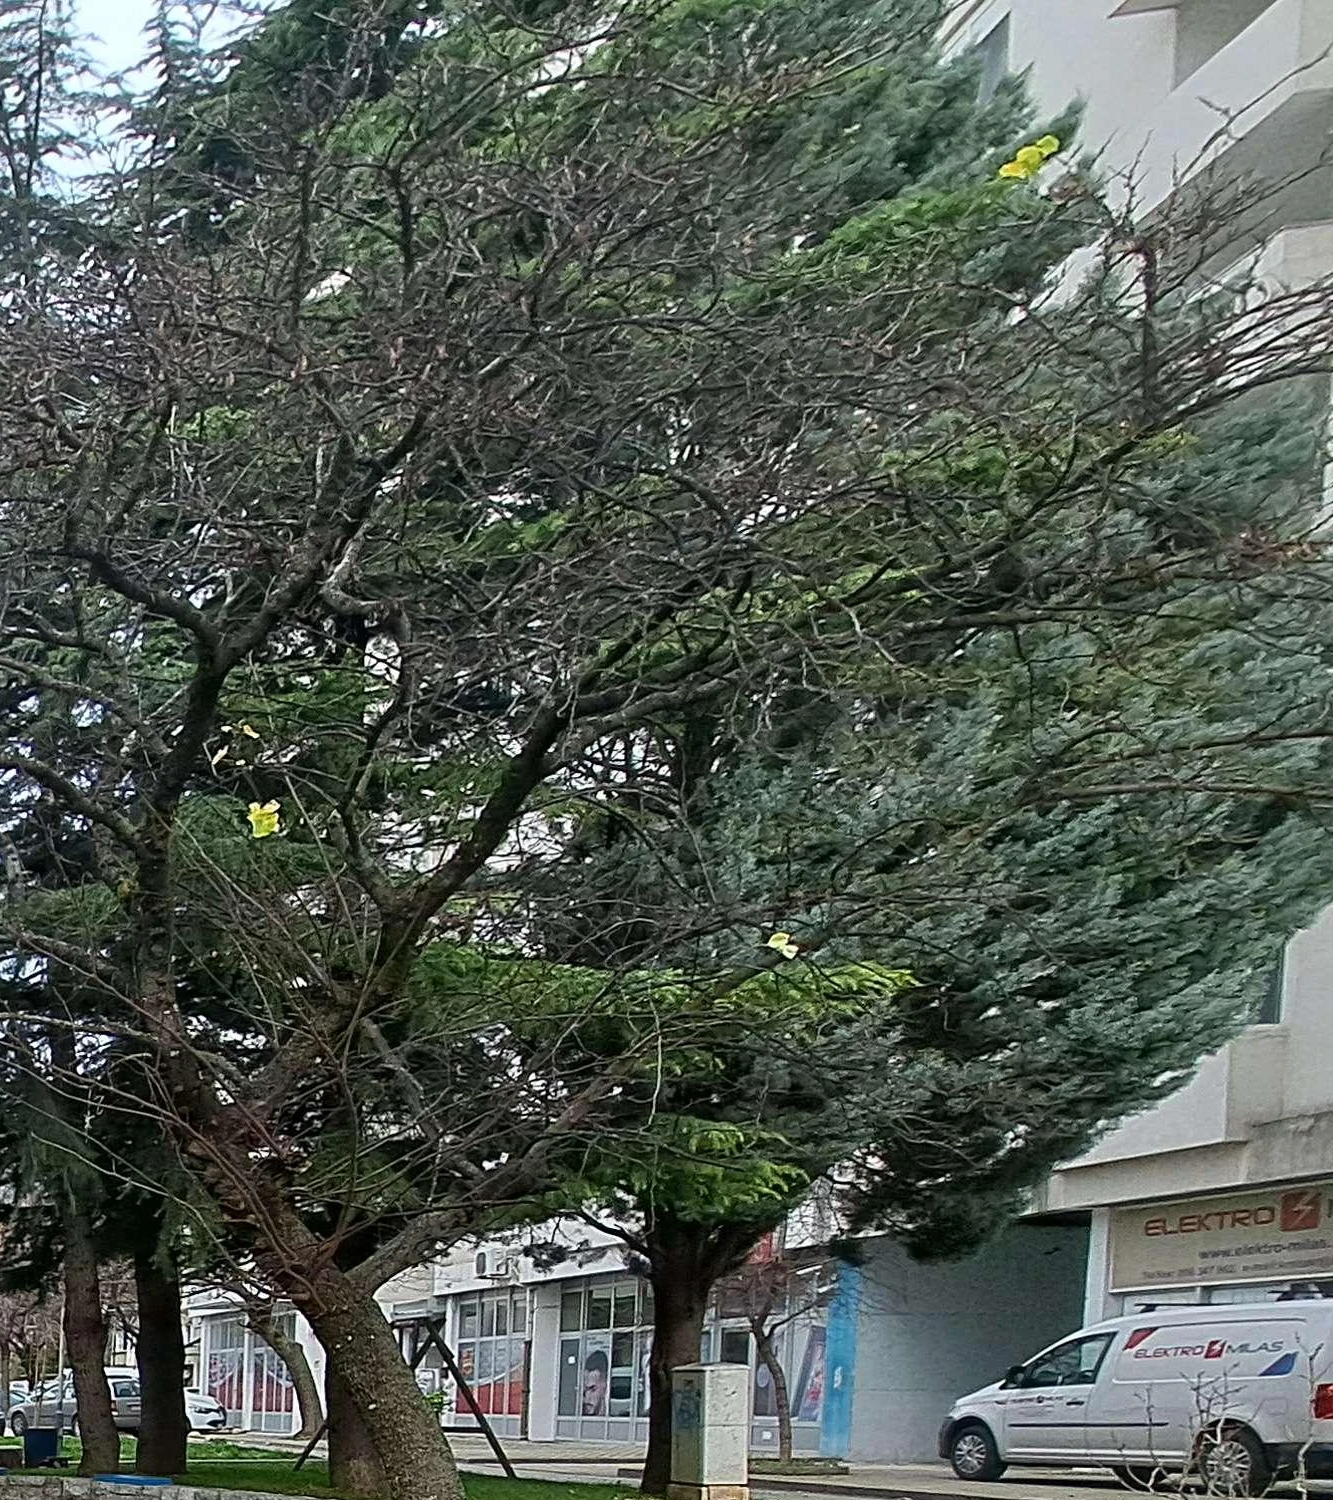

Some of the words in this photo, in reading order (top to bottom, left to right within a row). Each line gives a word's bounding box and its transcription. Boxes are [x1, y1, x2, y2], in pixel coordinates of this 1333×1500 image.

[1144, 1206, 1275, 1237] ELEKTRO
[1134, 1345, 1204, 1358] ELEKTRO
[1226, 1341, 1283, 1353] MILAS
